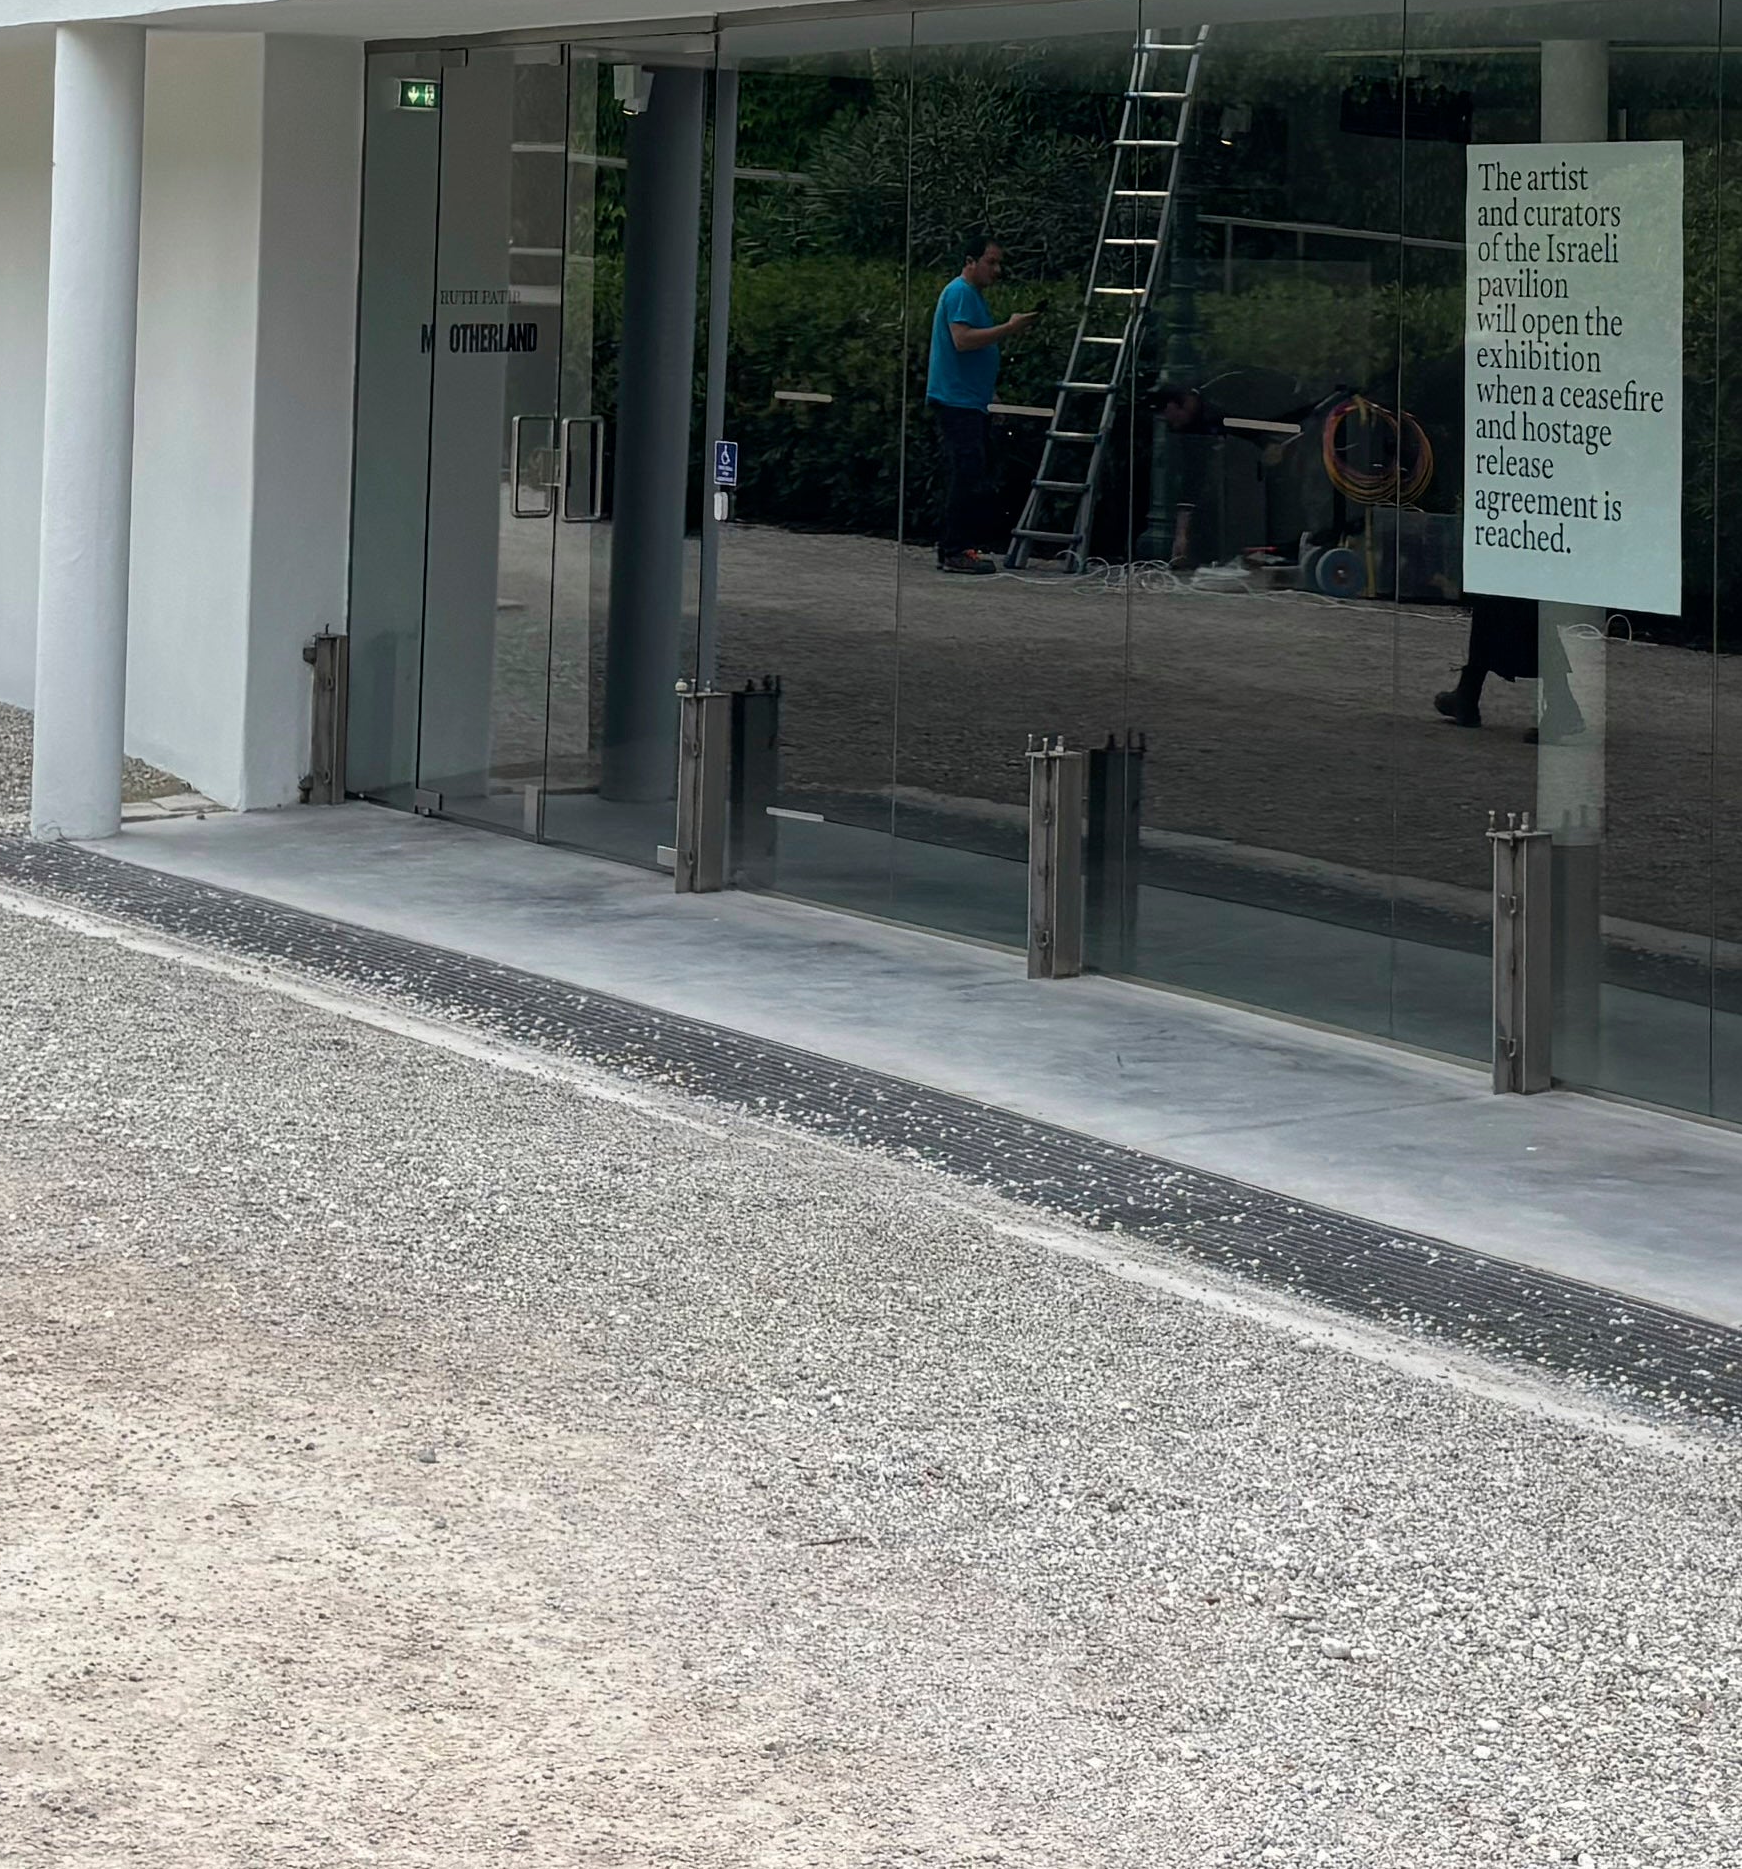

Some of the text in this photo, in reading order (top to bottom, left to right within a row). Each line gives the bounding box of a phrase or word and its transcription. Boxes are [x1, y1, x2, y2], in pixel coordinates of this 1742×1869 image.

[1478, 161, 1589, 192] The artist
[1477, 197, 1621, 227] and curators
[1478, 232, 1619, 264] of the Israeli
[1478, 268, 1569, 306] pavilion
[1477, 303, 1623, 344] will open the
[1477, 339, 1602, 373] exhibition
[1476, 374, 1664, 413] when a ceasefire
[1476, 411, 1612, 456] and hostage
[1476, 445, 1554, 480] release
[1475, 489, 1623, 522] agreement is
[1475, 519, 1572, 555] reached.
